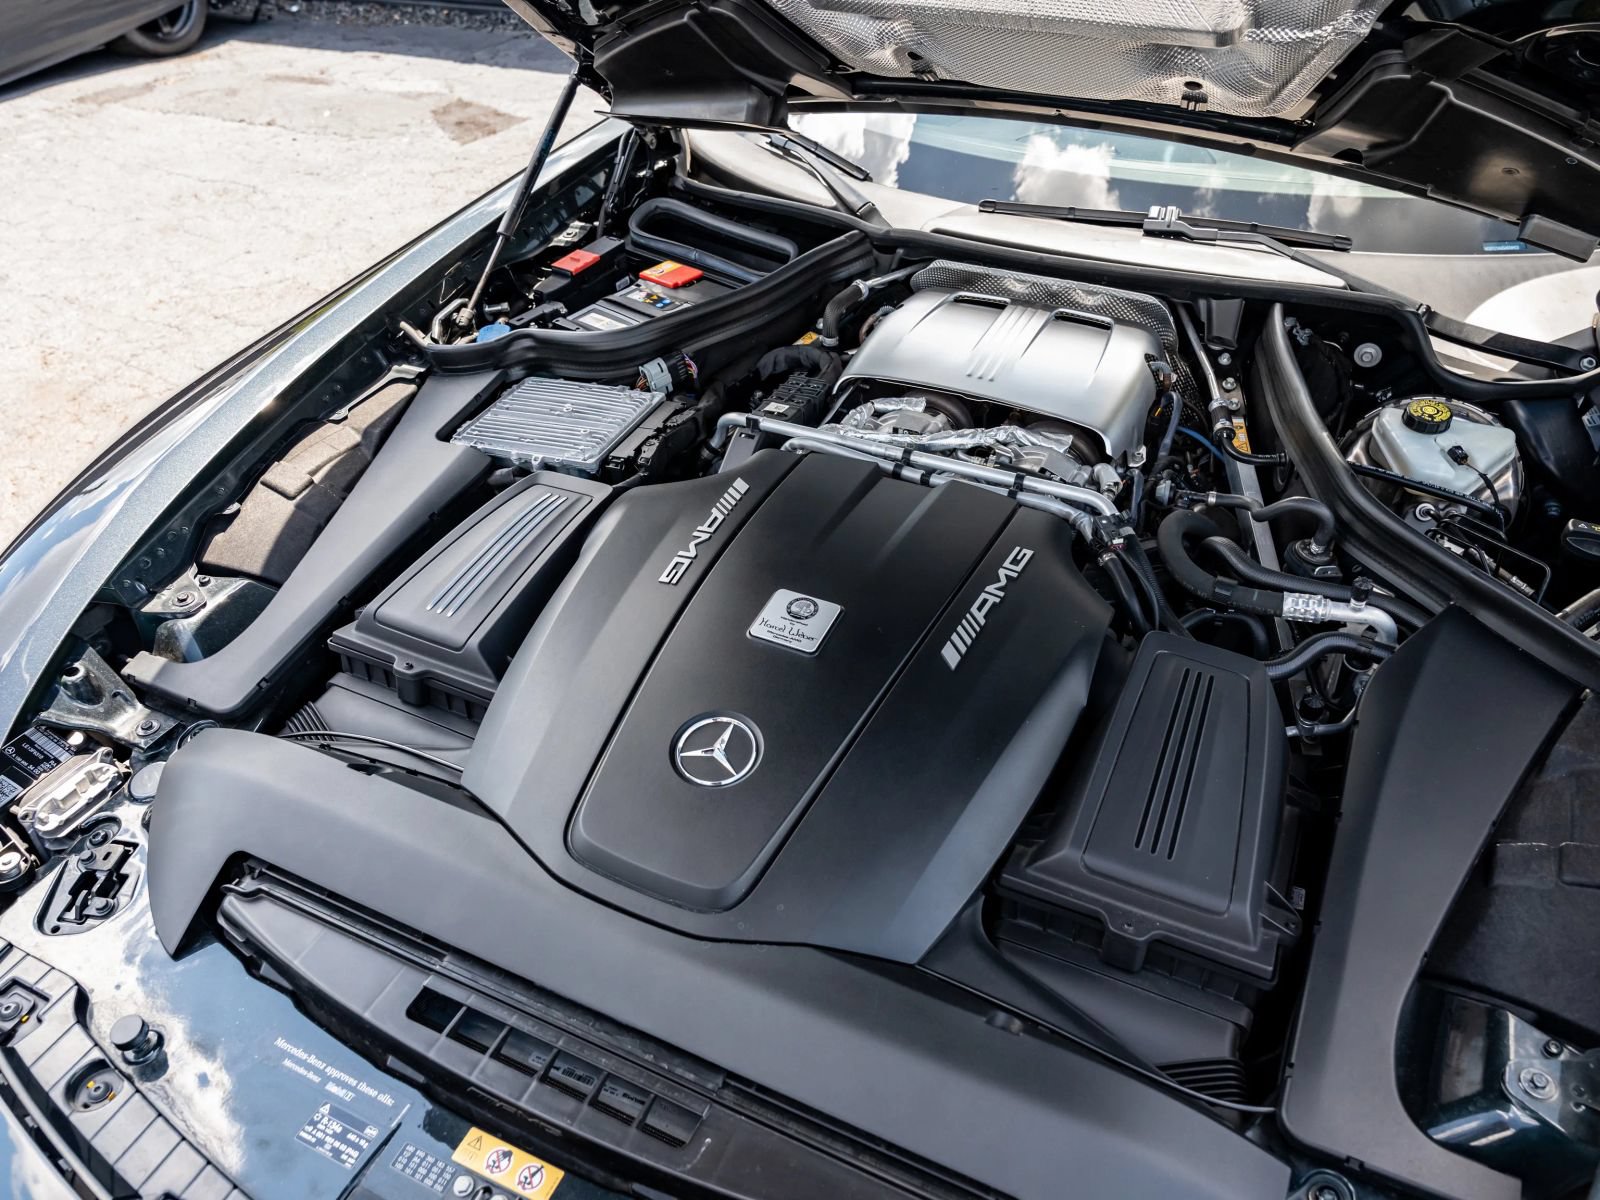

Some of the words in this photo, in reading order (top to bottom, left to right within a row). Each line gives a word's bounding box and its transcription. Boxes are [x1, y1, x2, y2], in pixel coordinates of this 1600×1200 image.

[658, 505, 727, 584] AMG
[274, 1037, 327, 1070] Mercedes-Benz
[325, 1066, 358, 1087] approves
[357, 1081, 378, 1098] these
[377, 1093, 395, 1107] oils:
[282, 1058, 321, 1083] Mercedes-Benz
